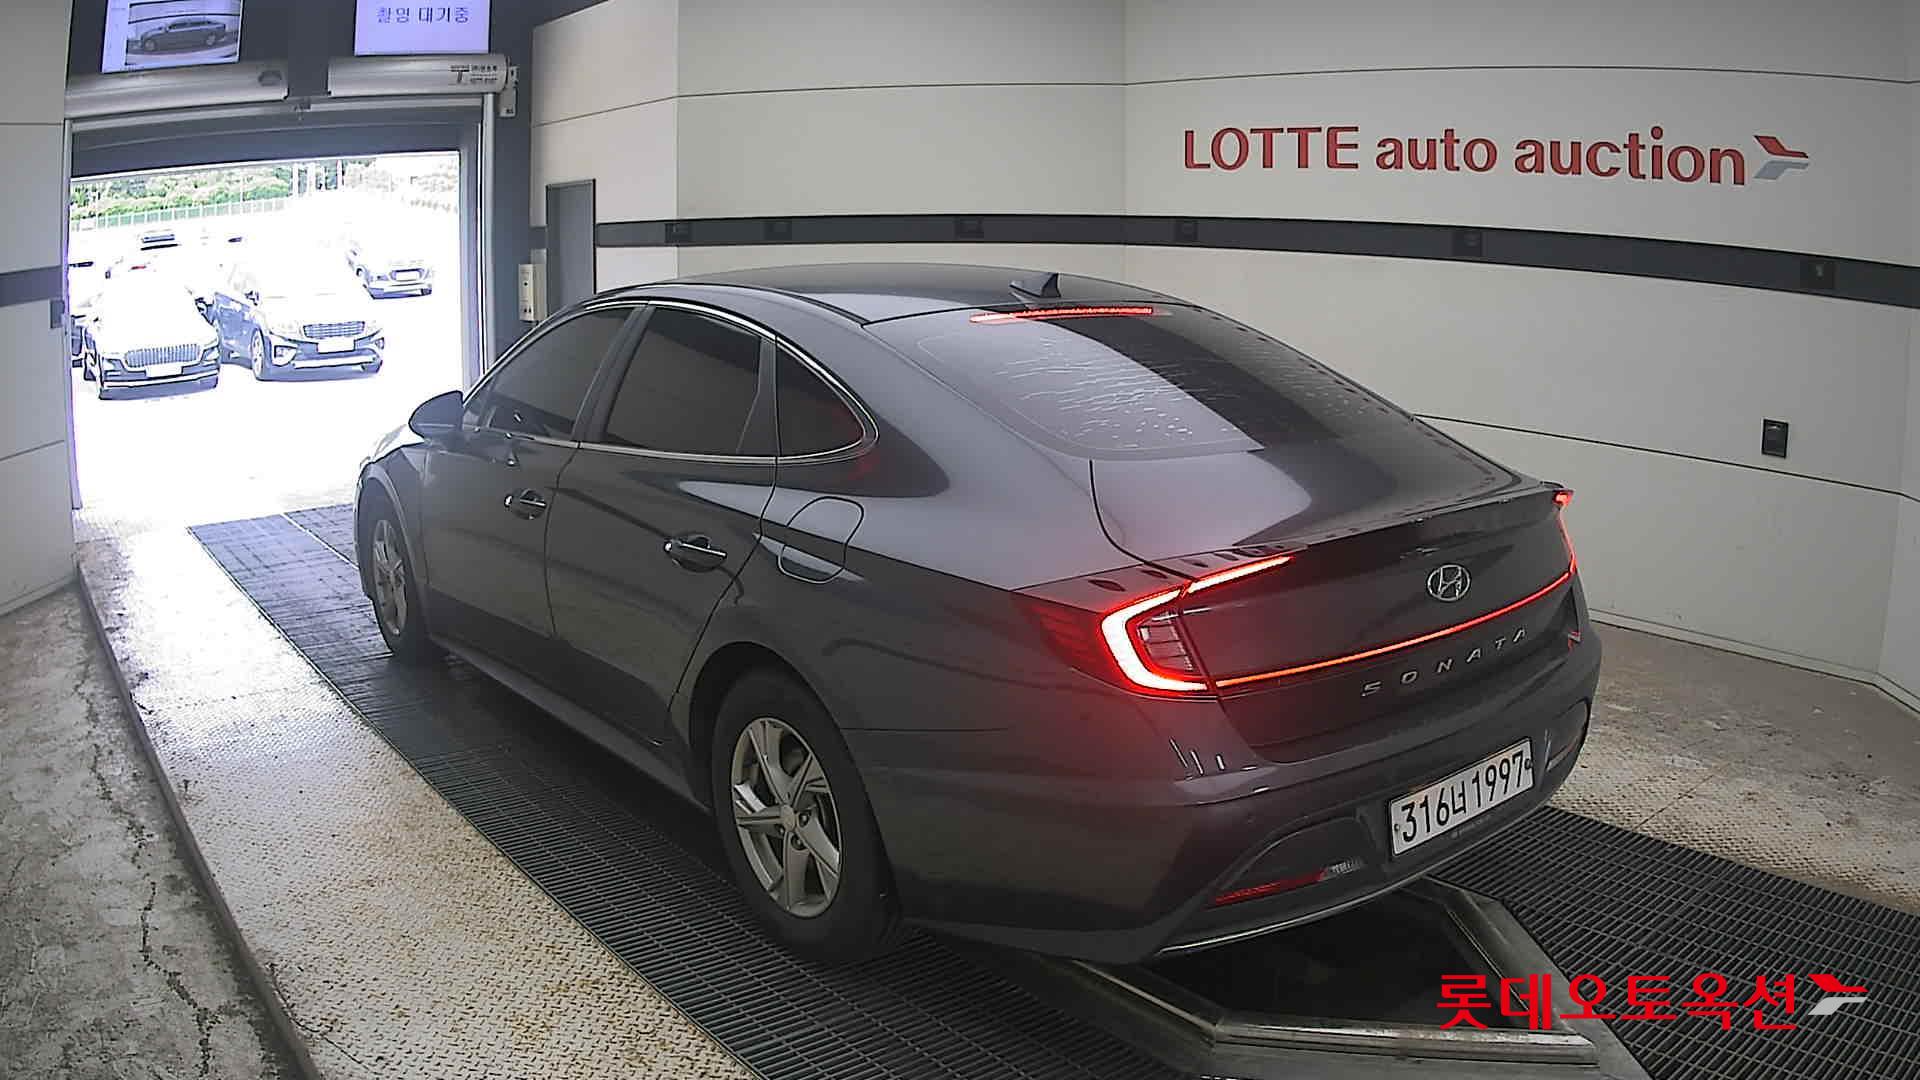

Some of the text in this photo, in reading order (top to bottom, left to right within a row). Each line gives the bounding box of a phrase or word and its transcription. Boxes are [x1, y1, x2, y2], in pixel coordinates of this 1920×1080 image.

[418, 7, 469, 23] 대기중
[1184, 126, 1746, 186] LOTTE auto auction
[1362, 628, 1527, 697] SONATA
